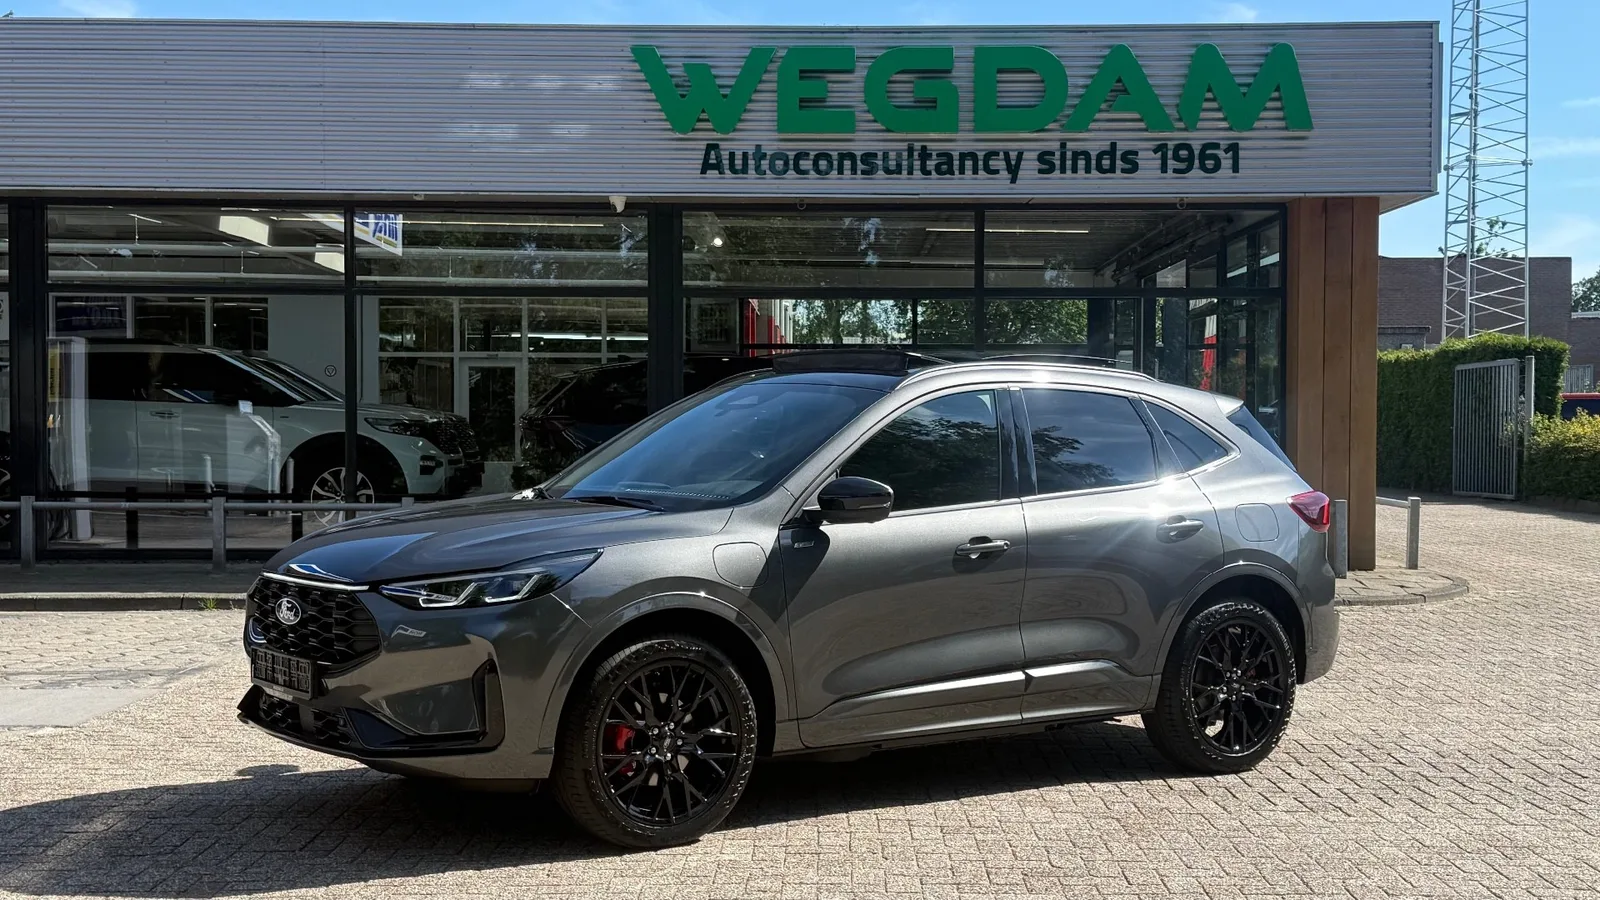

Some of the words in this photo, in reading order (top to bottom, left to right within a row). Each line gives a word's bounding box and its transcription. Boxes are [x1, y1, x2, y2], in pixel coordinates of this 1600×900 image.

[632, 44, 1312, 134] WEGDAM
[700, 143, 1024, 184] Autoconsultancy
[1037, 142, 1140, 175] sinds
[1152, 142, 1240, 174] 1961
